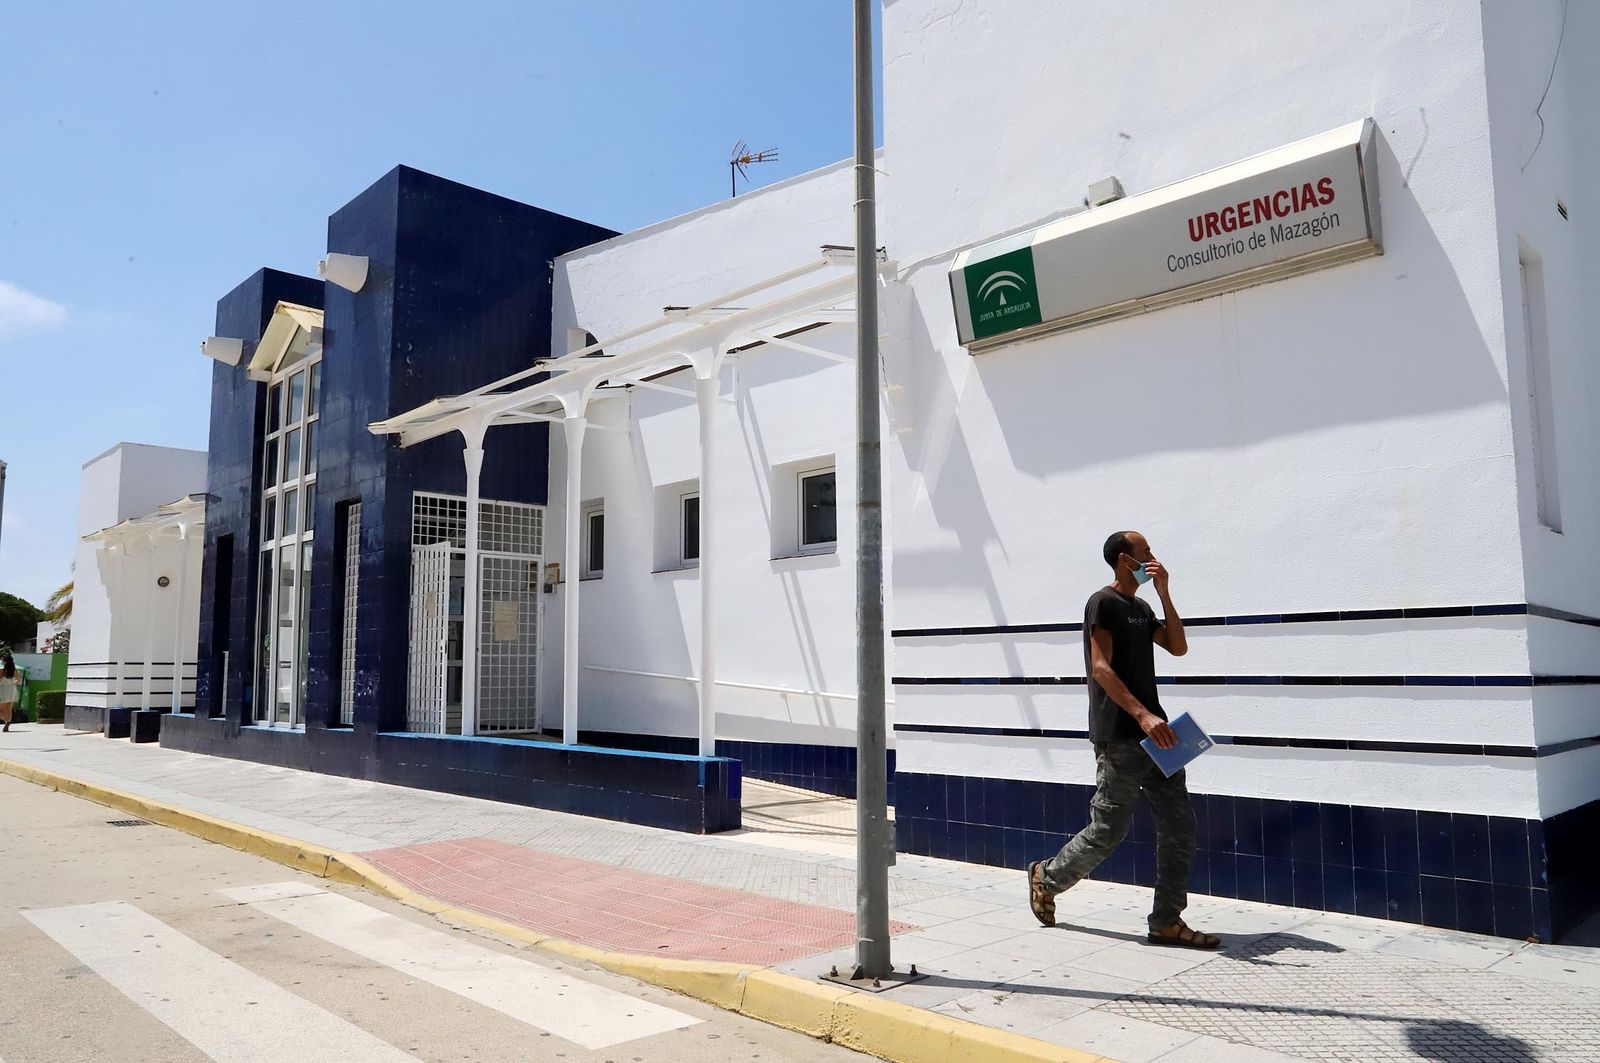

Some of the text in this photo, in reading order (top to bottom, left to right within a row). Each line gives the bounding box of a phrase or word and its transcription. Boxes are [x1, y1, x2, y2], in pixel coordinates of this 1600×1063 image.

[1188, 177, 1335, 242] URGENCIAS
[1167, 212, 1340, 272] Consultorio de Mazagón
[980, 312, 995, 322] JUNTA
[996, 309, 1003, 318] DE
